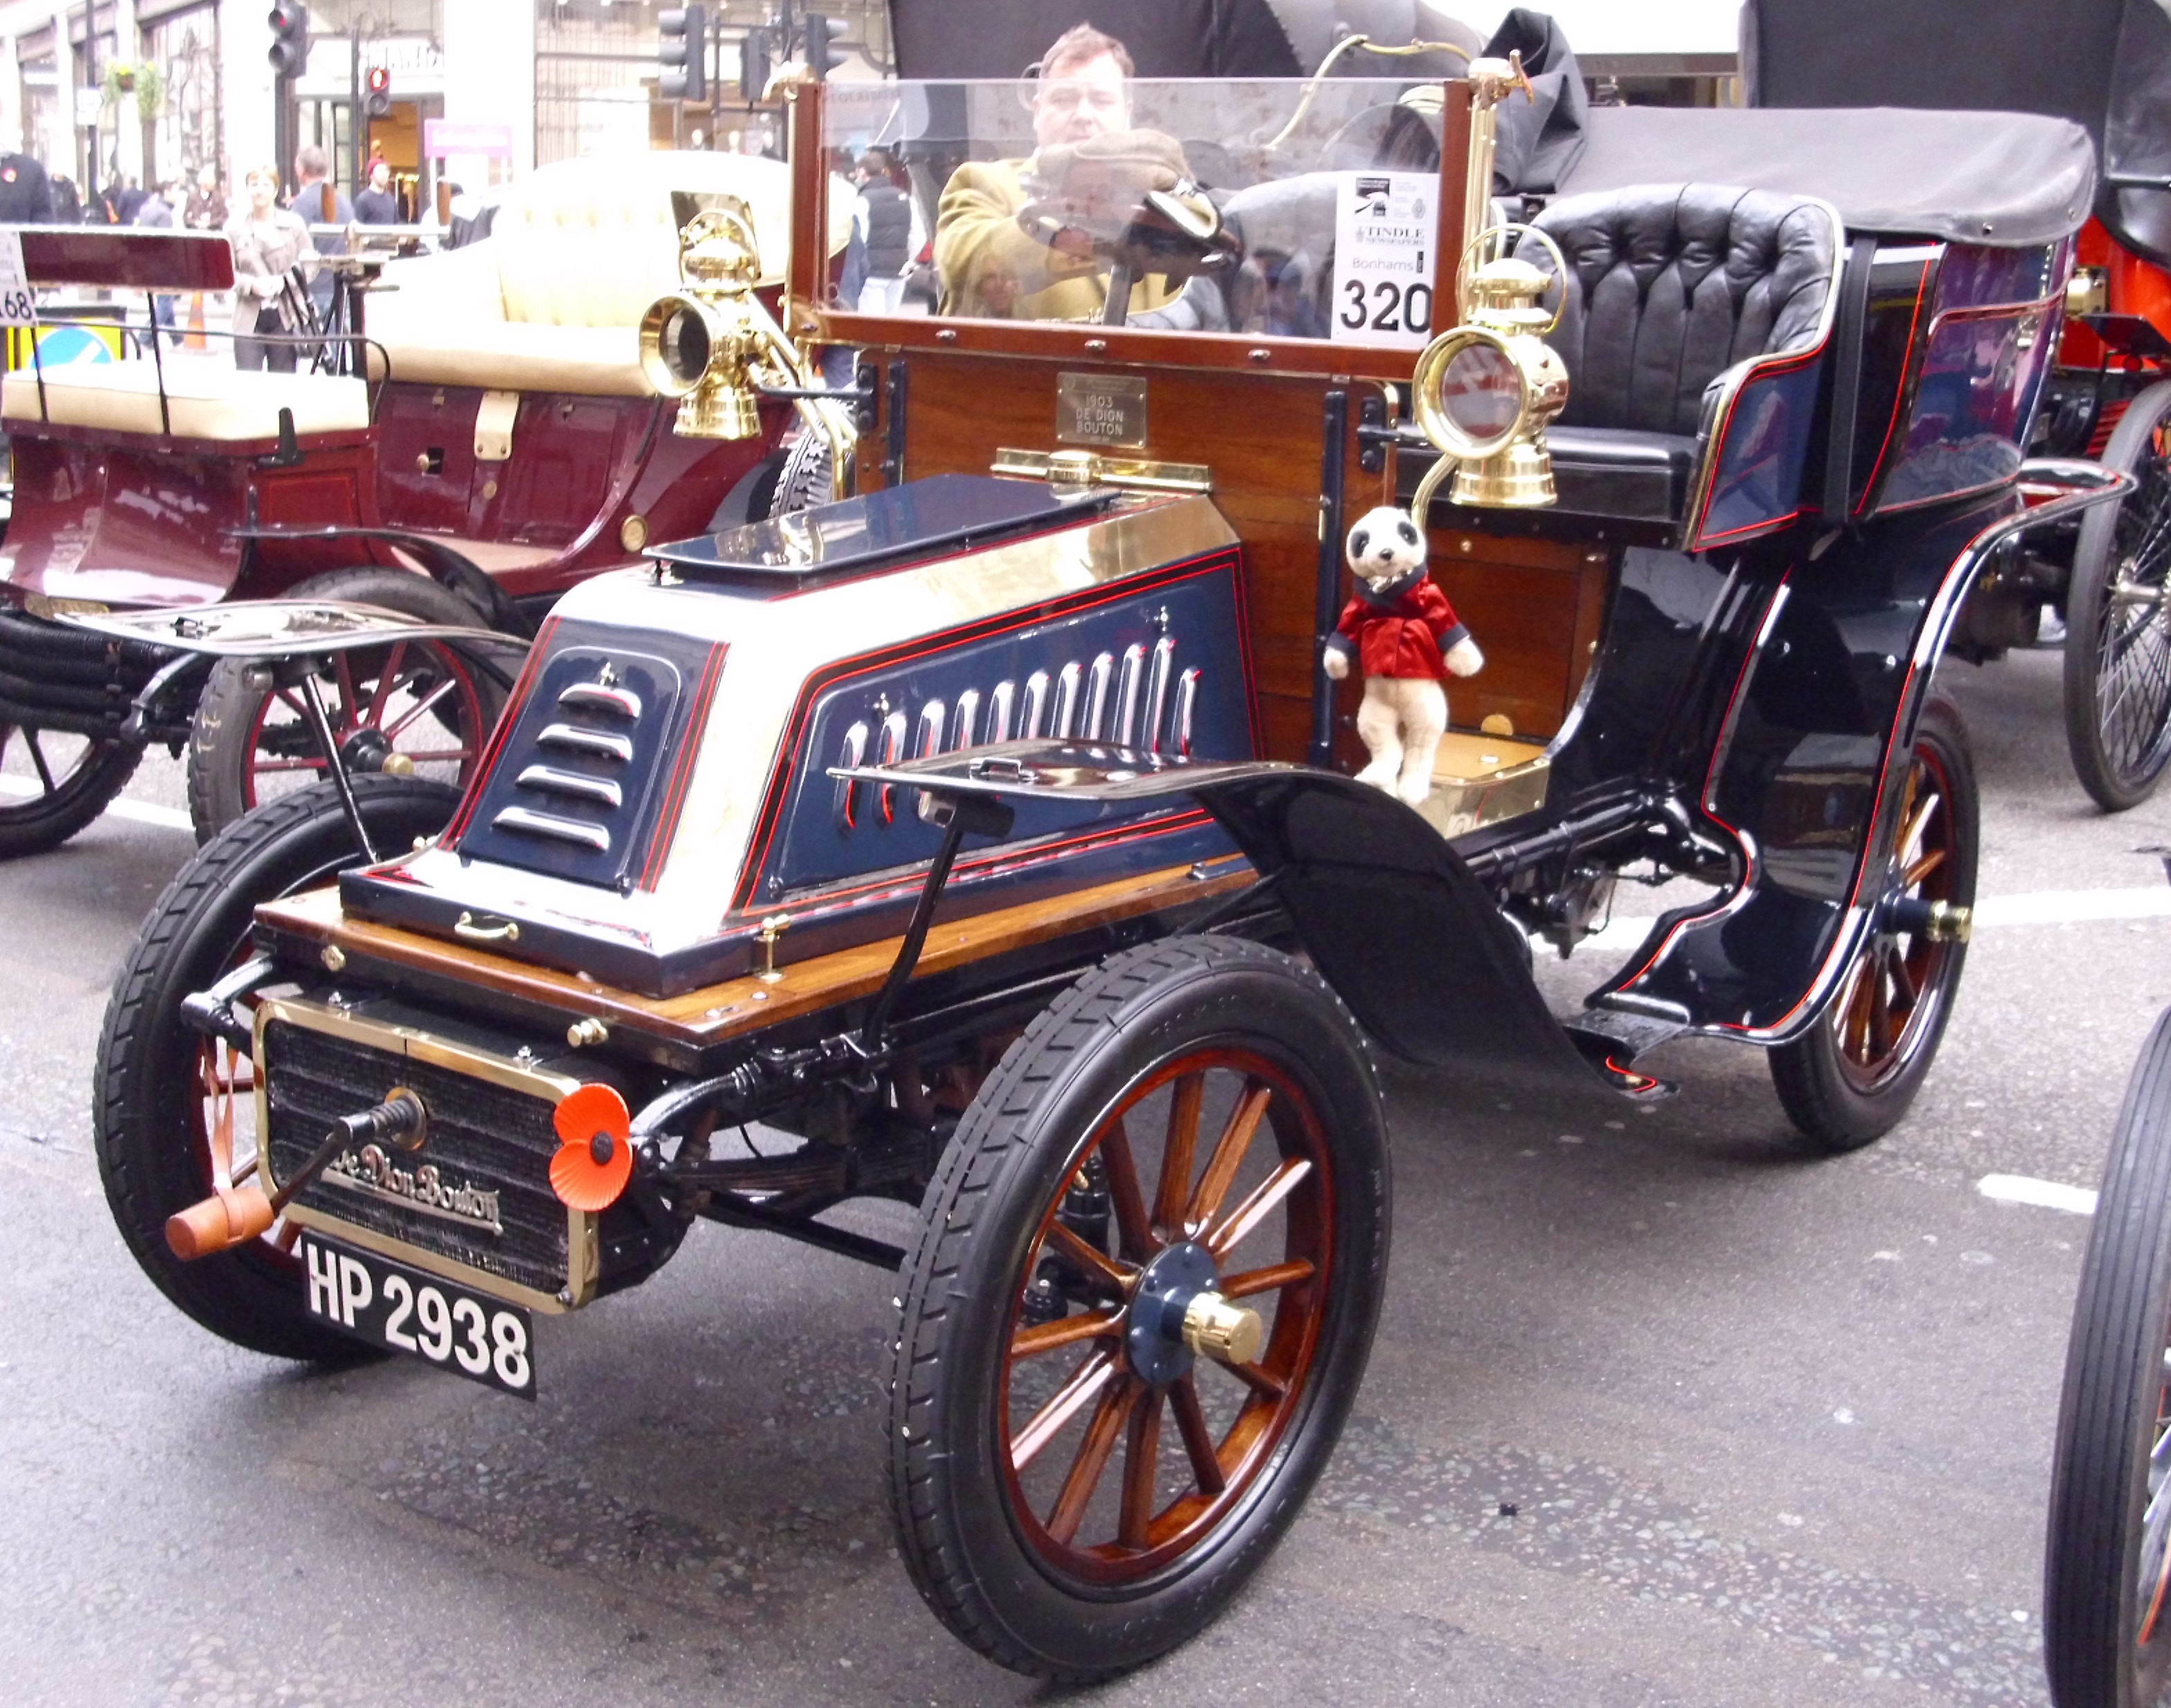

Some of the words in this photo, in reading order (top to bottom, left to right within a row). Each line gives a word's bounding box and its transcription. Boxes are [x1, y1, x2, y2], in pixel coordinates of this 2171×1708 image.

[1366, 226, 1424, 238] TINDLE
[1353, 257, 1413, 271] Bonhams
[0, 291, 32, 320] 68
[1341, 279, 1433, 334] 320
[1086, 394, 1113, 408] 1903
[1076, 408, 1091, 420] DE
[1096, 409, 1123, 422] DION
[1076, 421, 1123, 435] BOUTON
[415, 1165, 500, 1222] Bouton
[307, 1243, 372, 1327] HP
[383, 1274, 530, 1388] 2938
